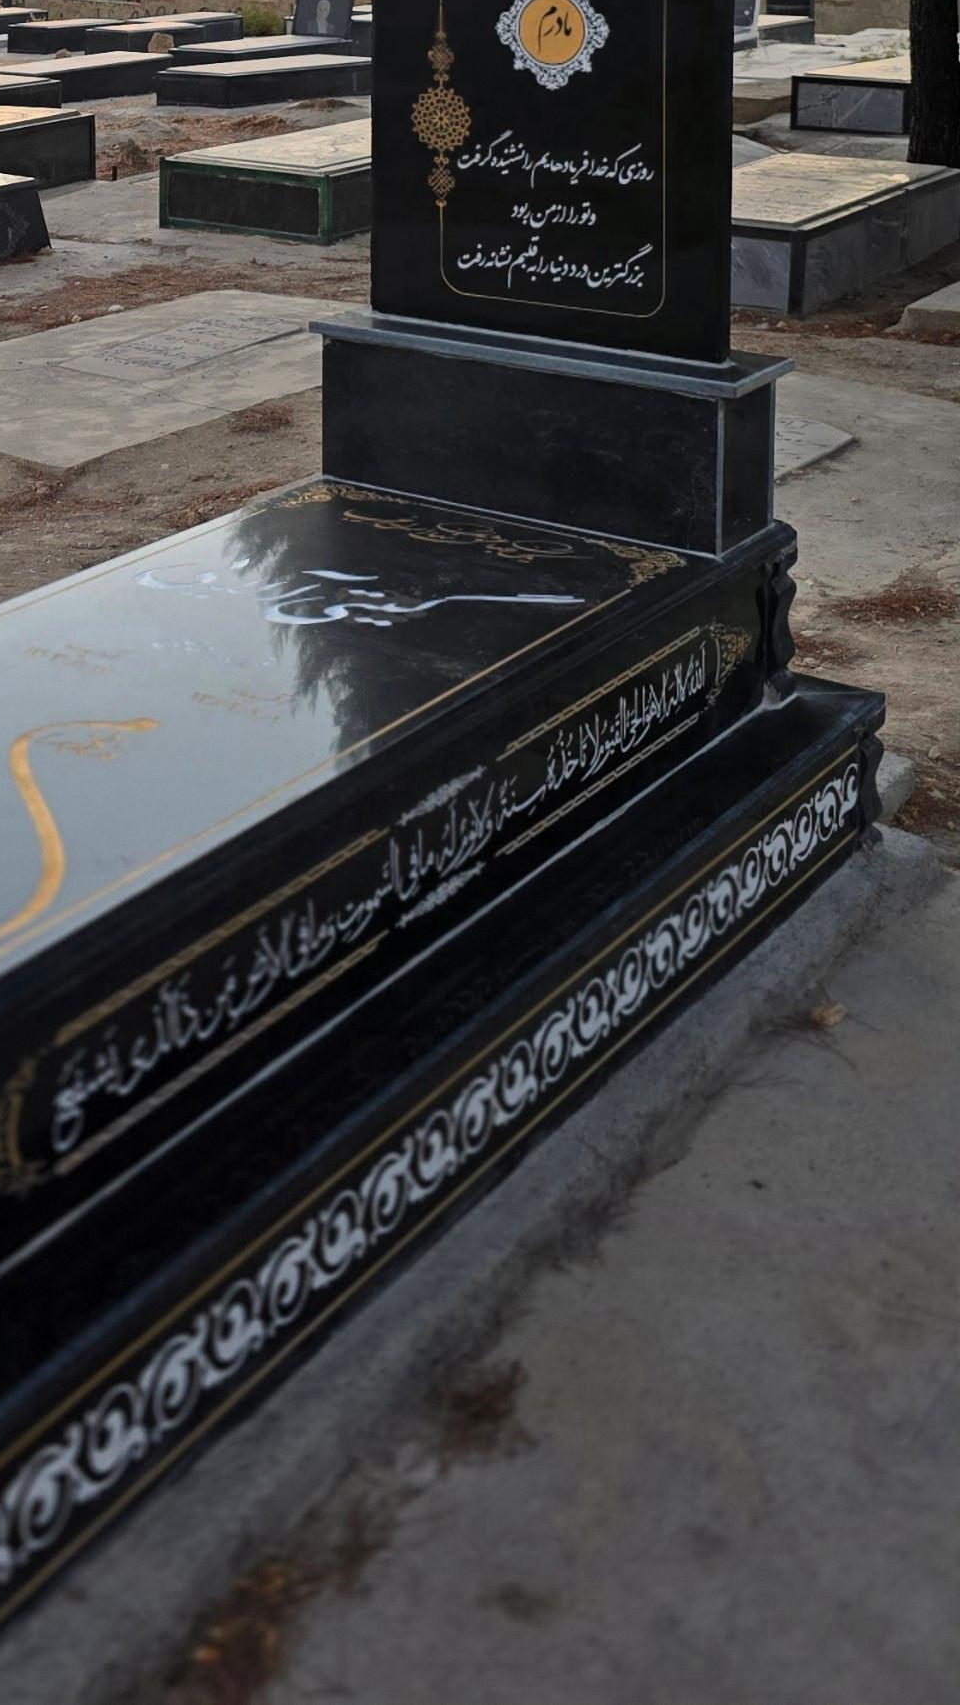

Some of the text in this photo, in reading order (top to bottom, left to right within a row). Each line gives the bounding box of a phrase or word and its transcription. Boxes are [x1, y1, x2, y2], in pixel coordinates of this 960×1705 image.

[537, 6, 572, 55] مادرم
[457, 130, 513, 170] گرفت
[521, 153, 533, 171] را
[605, 143, 642, 179] که
[587, 157, 609, 177] خدا
[618, 161, 654, 185] روزی
[510, 202, 531, 225] ربود
[529, 204, 557, 229] من
[551, 204, 567, 223] از
[457, 243, 487, 270] رفت
[483, 244, 513, 268] نشانه
[507, 235, 540, 288] قلبم
[549, 255, 569, 282] دنیا
[586, 243, 654, 288] بزرگترین
[568, 263, 589, 279] درد
